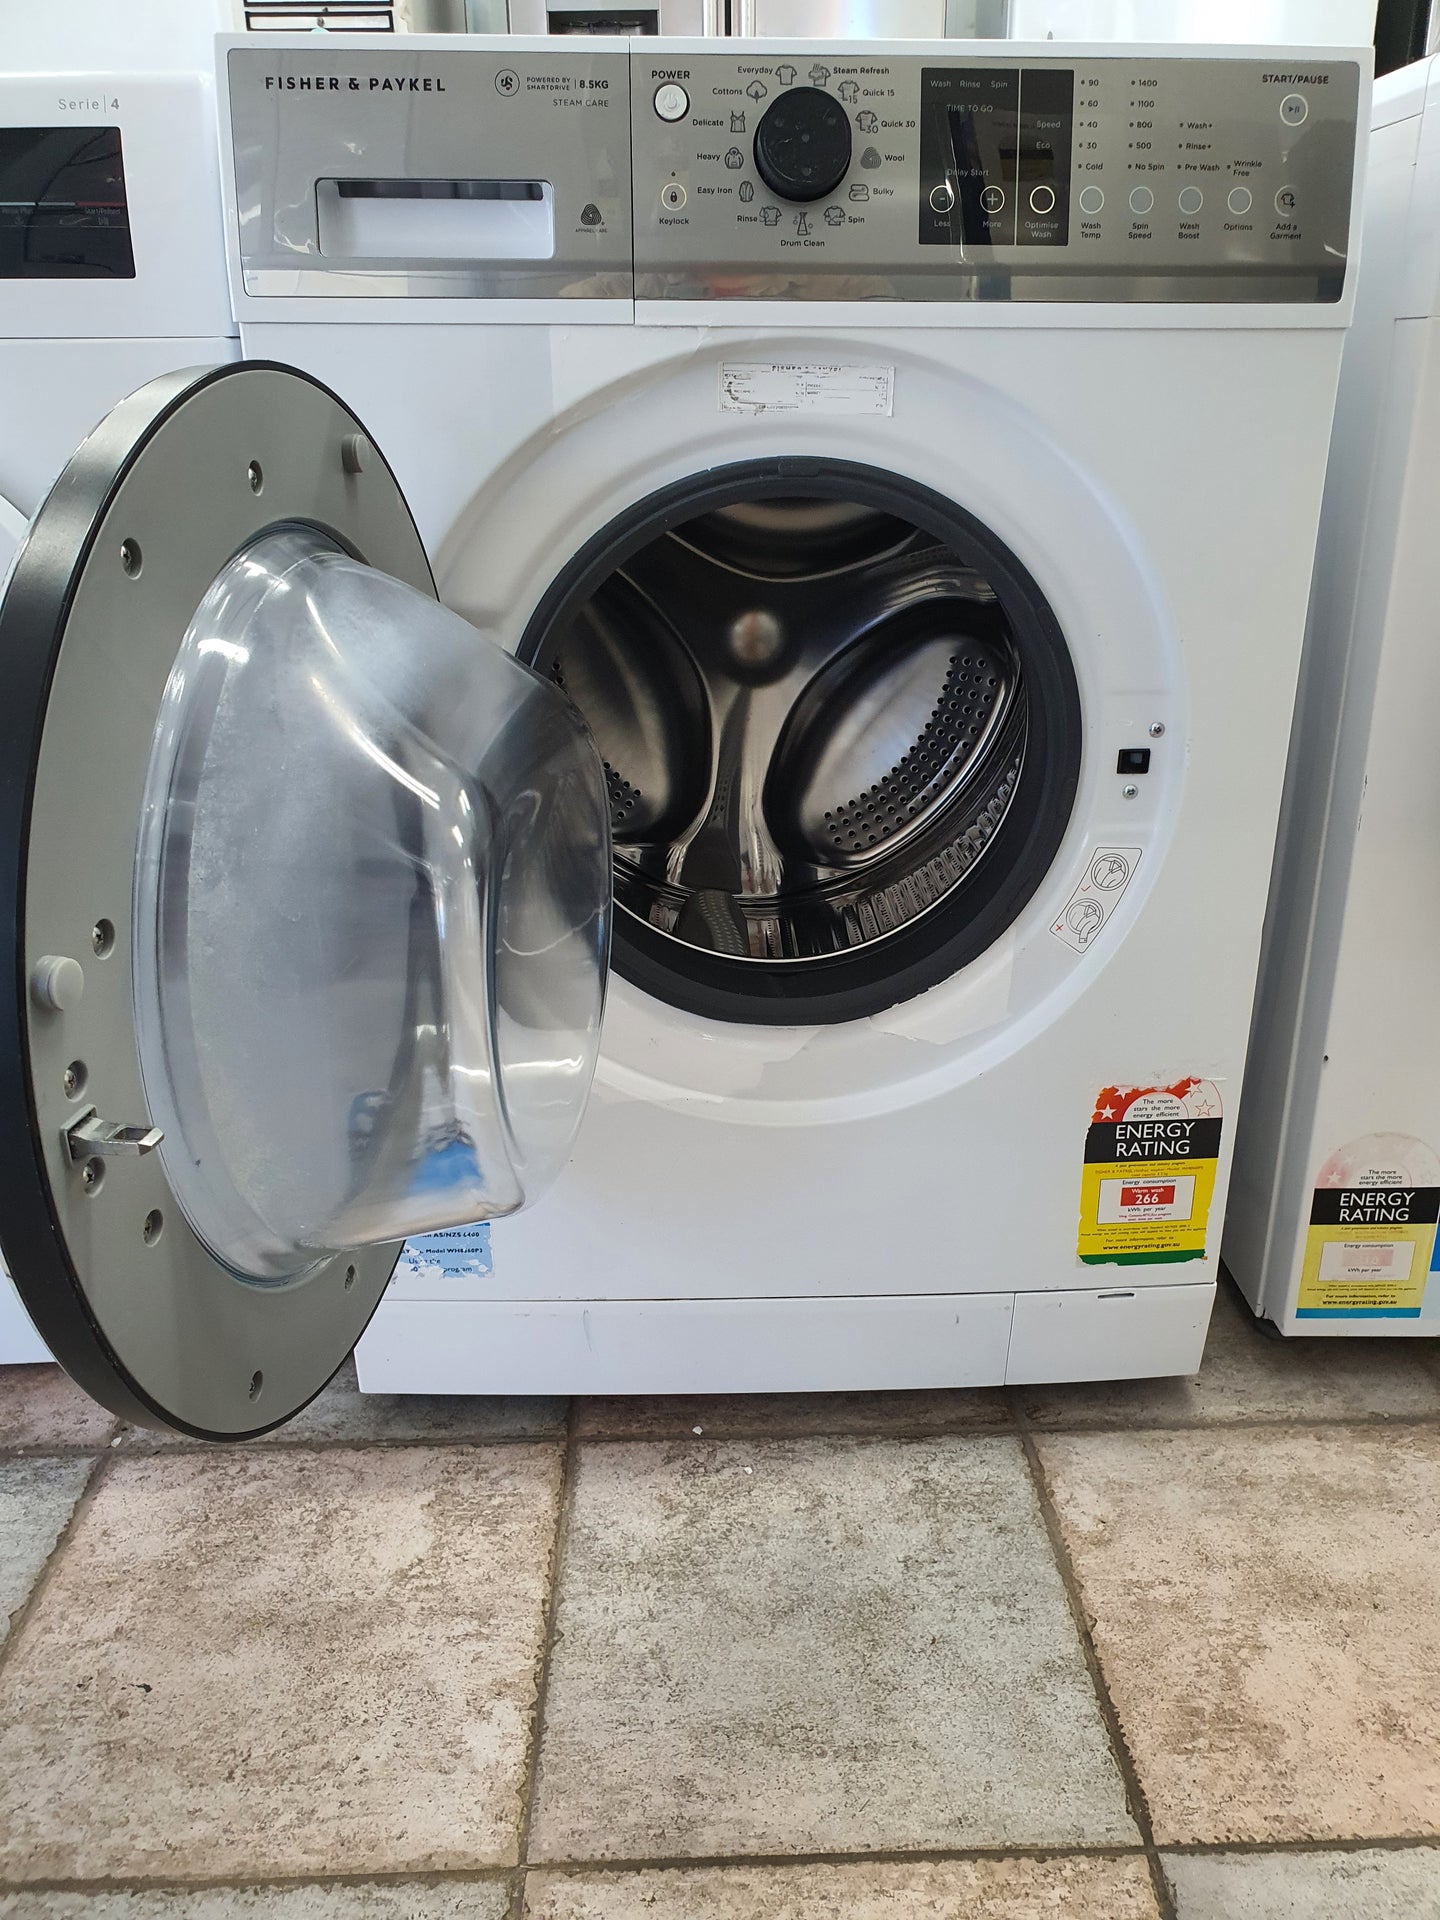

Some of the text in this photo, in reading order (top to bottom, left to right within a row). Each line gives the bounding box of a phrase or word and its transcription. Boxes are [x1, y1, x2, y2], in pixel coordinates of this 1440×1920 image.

[651, 70, 690, 80] POWER
[737, 66, 773, 75] Everyday
[833, 66, 890, 75] Steam Refresh
[265, 76, 446, 92] FISHER & PAYKEL
[579, 79, 609, 89] 8.5KG
[1088, 79, 1099, 87] 90
[1138, 79, 1158, 87] 1400
[1262, 74, 1329, 85] START/PAUSE
[930, 80, 1008, 89] Wash Rinse Spin
[712, 87, 743, 96] Cottons
[862, 88, 895, 97] Quick 15
[58, 98, 120, 110] Serie 4
[552, 99, 609, 108] STEAM CARE
[1087, 100, 1099, 108] 60
[1137, 100, 1155, 108] 1100
[946, 104, 965, 112] TIME
[980, 105, 994, 113] GO
[692, 118, 724, 127] Delicate
[881, 120, 916, 129] Quick 30
[1036, 121, 1061, 129] Speed
[1136, 121, 1153, 129] 800
[1036, 141, 1050, 149] Eco
[1136, 142, 1152, 150] 500
[696, 153, 721, 162] Heavy
[884, 154, 905, 162] Wool
[1135, 163, 1165, 172] No Spin
[1185, 163, 1220, 171] Pre Wash
[1233, 160, 1262, 168] Wrinkle
[946, 169, 989, 177] Delay Start
[1233, 169, 1250, 177] Free
[697, 186, 733, 196] Easy Iron
[872, 187, 894, 197] Bulky
[659, 217, 689, 226] Keylock
[737, 215, 758, 223] Rinse
[848, 215, 865, 225] Spin
[1024, 221, 1059, 230] Optimise
[1132, 222, 1149, 231] Spin
[1179, 222, 1200, 230] Wash
[1223, 223, 1253, 232] Options
[1275, 223, 1292, 231] Add
[1081, 232, 1101, 240] Temp
[1128, 232, 1152, 240] Speed
[1270, 232, 1302, 240] Garment
[780, 239, 825, 247] Drum Clean
[1115, 1122, 1196, 1140] ENERGY
[1116, 1140, 1191, 1157] RATING
[1135, 1194, 1159, 1205] 266
[1339, 1191, 1416, 1207] ENERGY
[1339, 1208, 1410, 1222] RATING
[1103, 1242, 1181, 1251] www.energyrating.gov.au
